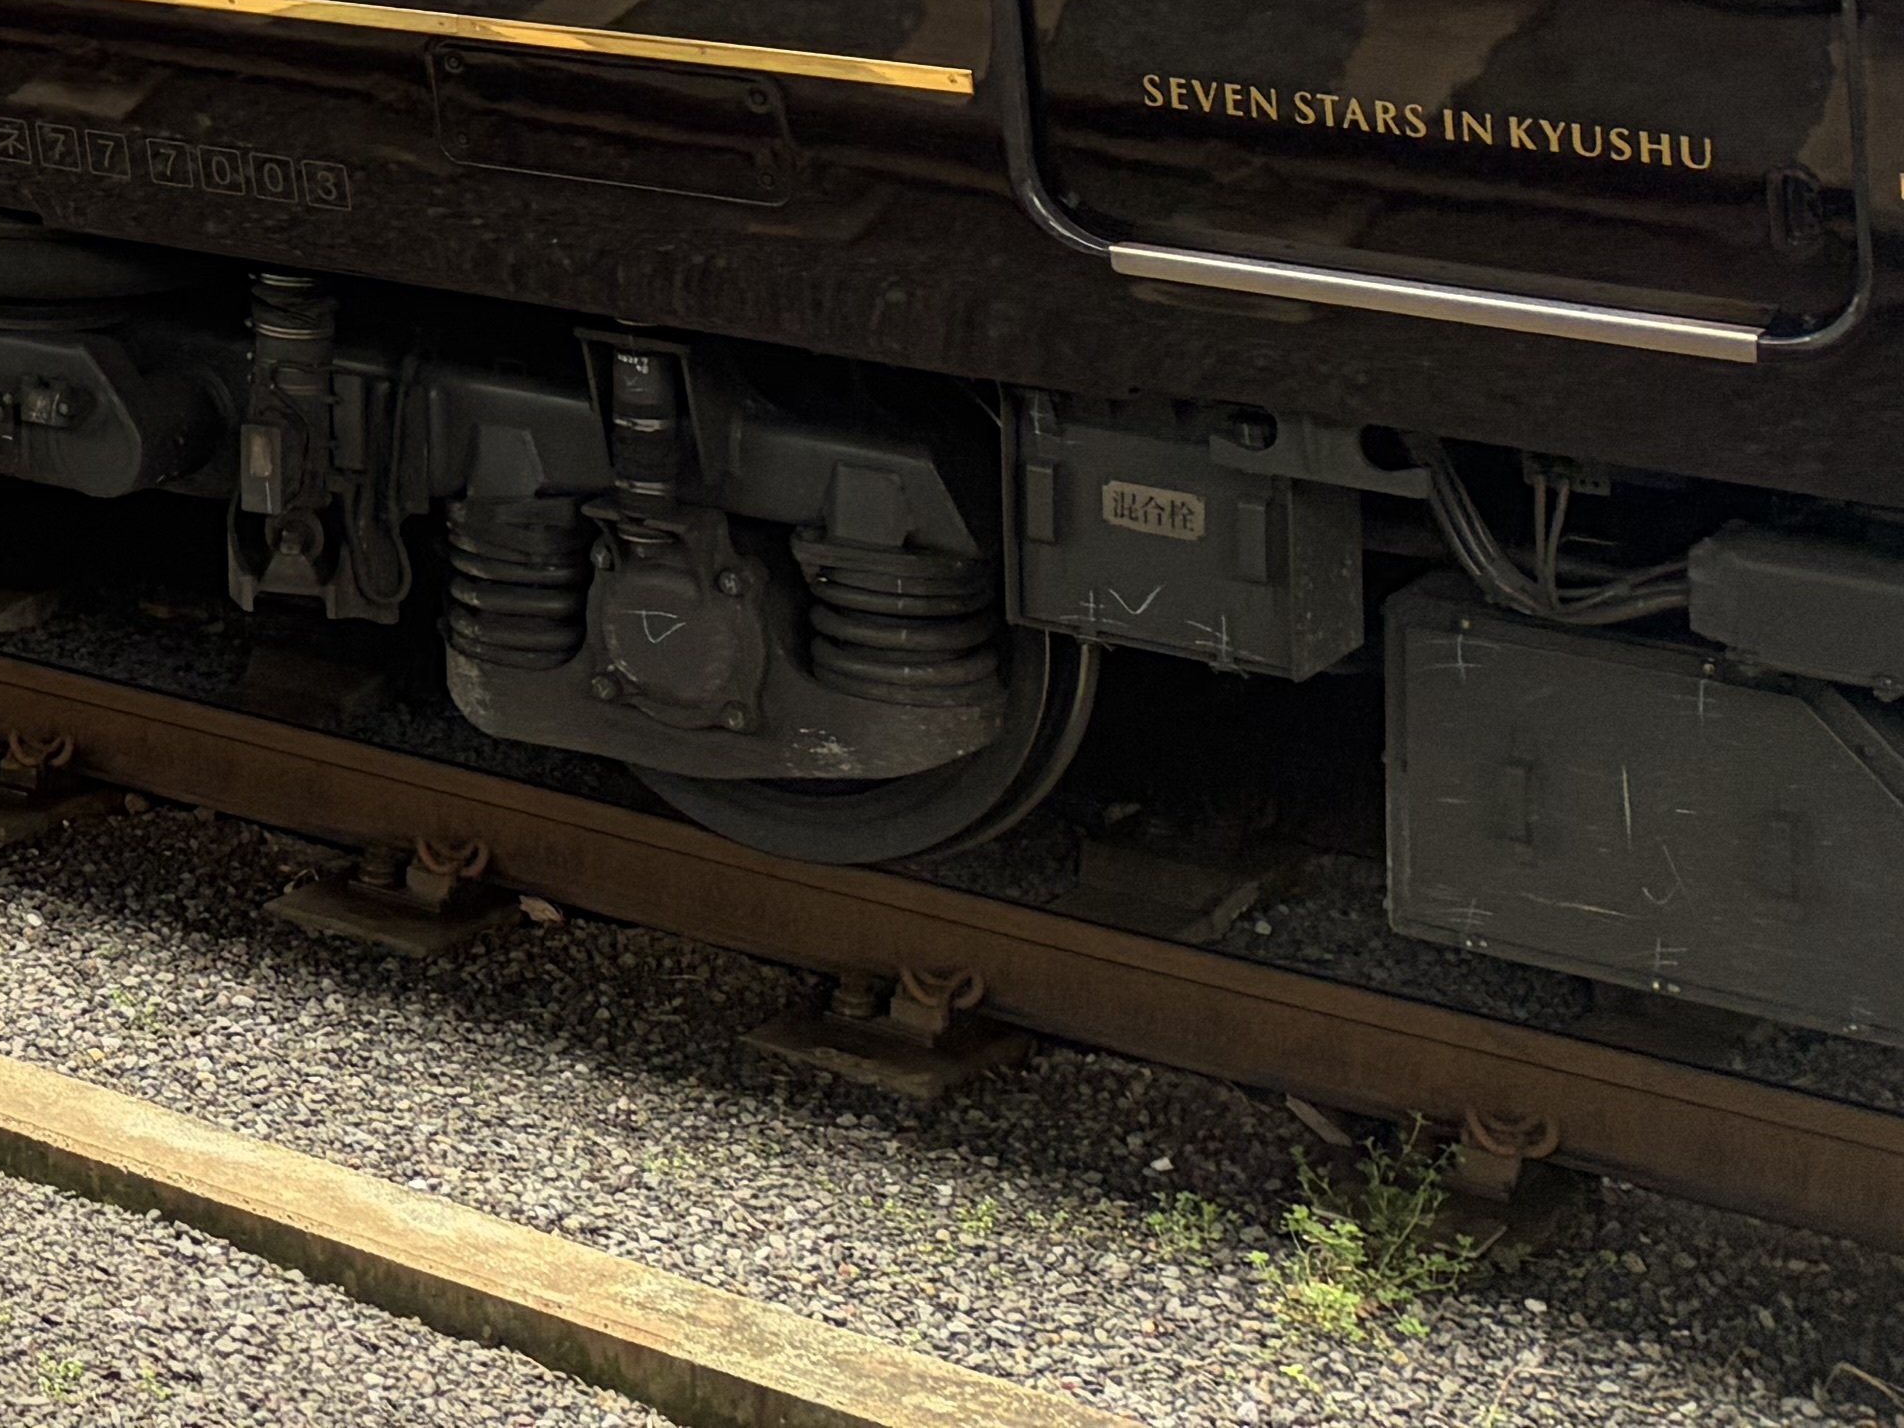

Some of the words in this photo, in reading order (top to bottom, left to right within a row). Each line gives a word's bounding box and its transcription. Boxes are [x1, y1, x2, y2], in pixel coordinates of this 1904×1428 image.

[1142, 74, 1278, 121] SEVEN
[1293, 90, 1427, 137] STARS
[1443, 108, 1493, 145] IN
[1508, 115, 1712, 171] KYUSHU
[146, 138, 352, 211] 7003
[1111, 489, 1196, 533] 混合栓
